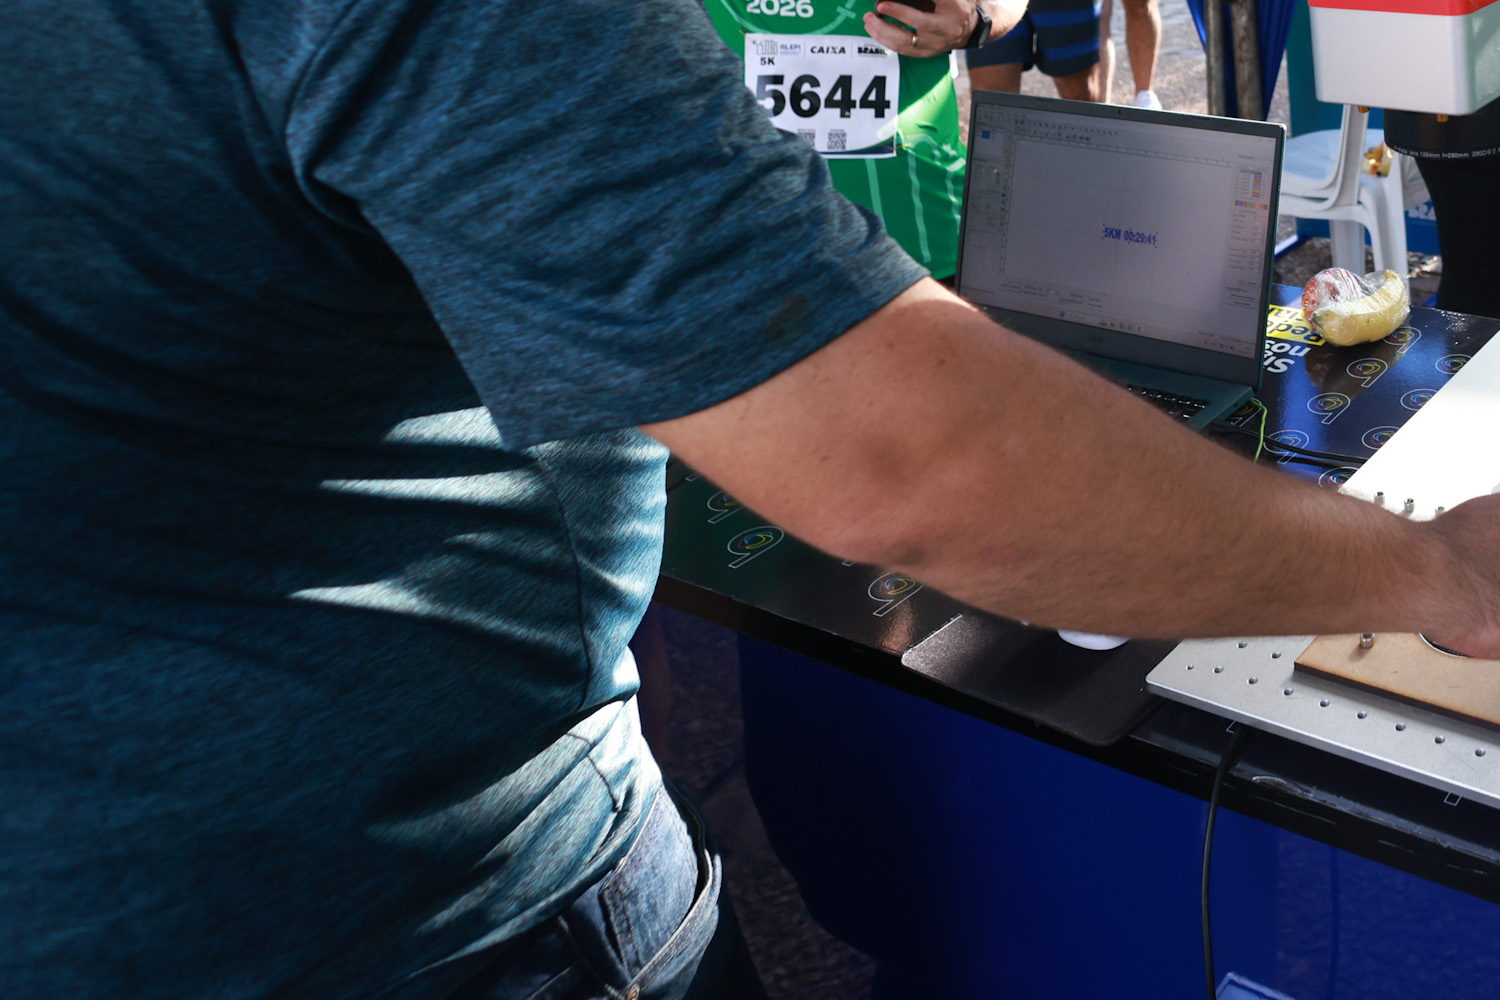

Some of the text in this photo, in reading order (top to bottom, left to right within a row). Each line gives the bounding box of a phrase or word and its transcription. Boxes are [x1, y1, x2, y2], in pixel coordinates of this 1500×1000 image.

[810, 46, 846, 55] CAIXA
[760, 57, 776, 66] 5K
[756, 73, 891, 118] 5644
